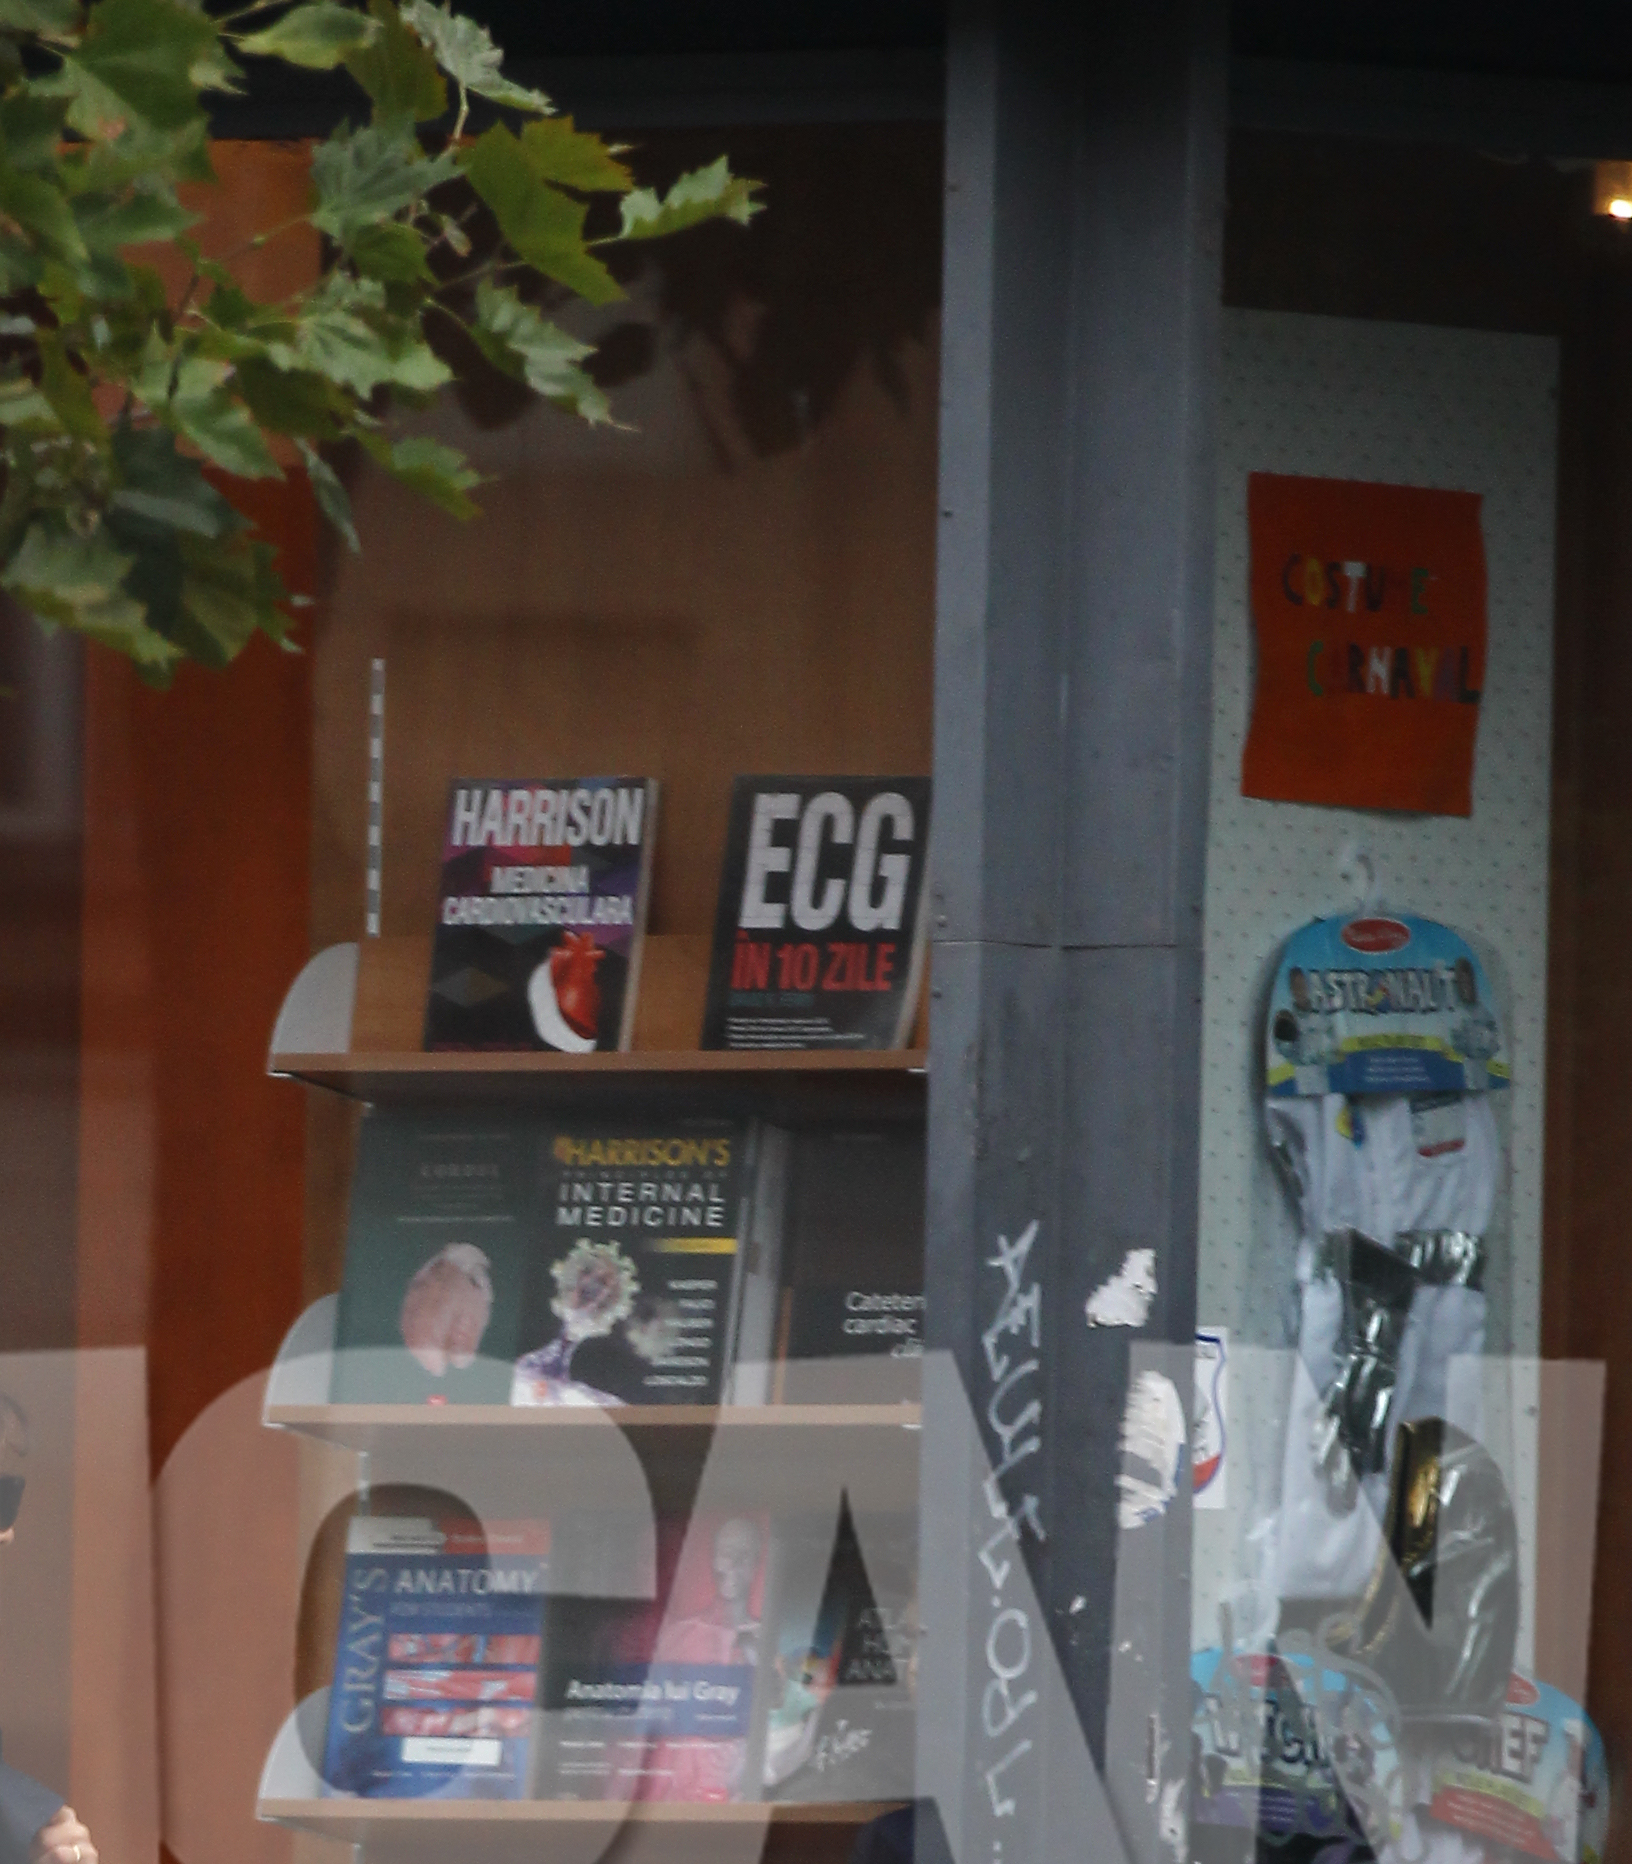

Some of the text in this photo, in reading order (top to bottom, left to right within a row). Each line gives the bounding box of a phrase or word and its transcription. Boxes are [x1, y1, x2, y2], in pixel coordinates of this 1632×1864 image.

[1282, 553, 1429, 616] COSTUE
[451, 788, 644, 847] HARRISON
[737, 791, 916, 933] ECG
[777, 942, 819, 992] 10
[821, 942, 897, 993] ZILE
[560, 1181, 726, 1203] INTERNAL
[556, 1205, 725, 1228] MEDICINE
[393, 1568, 538, 1595] ANATOMY
[565, 1680, 661, 1700] Anatomia
[692, 1680, 742, 1706] Gray
